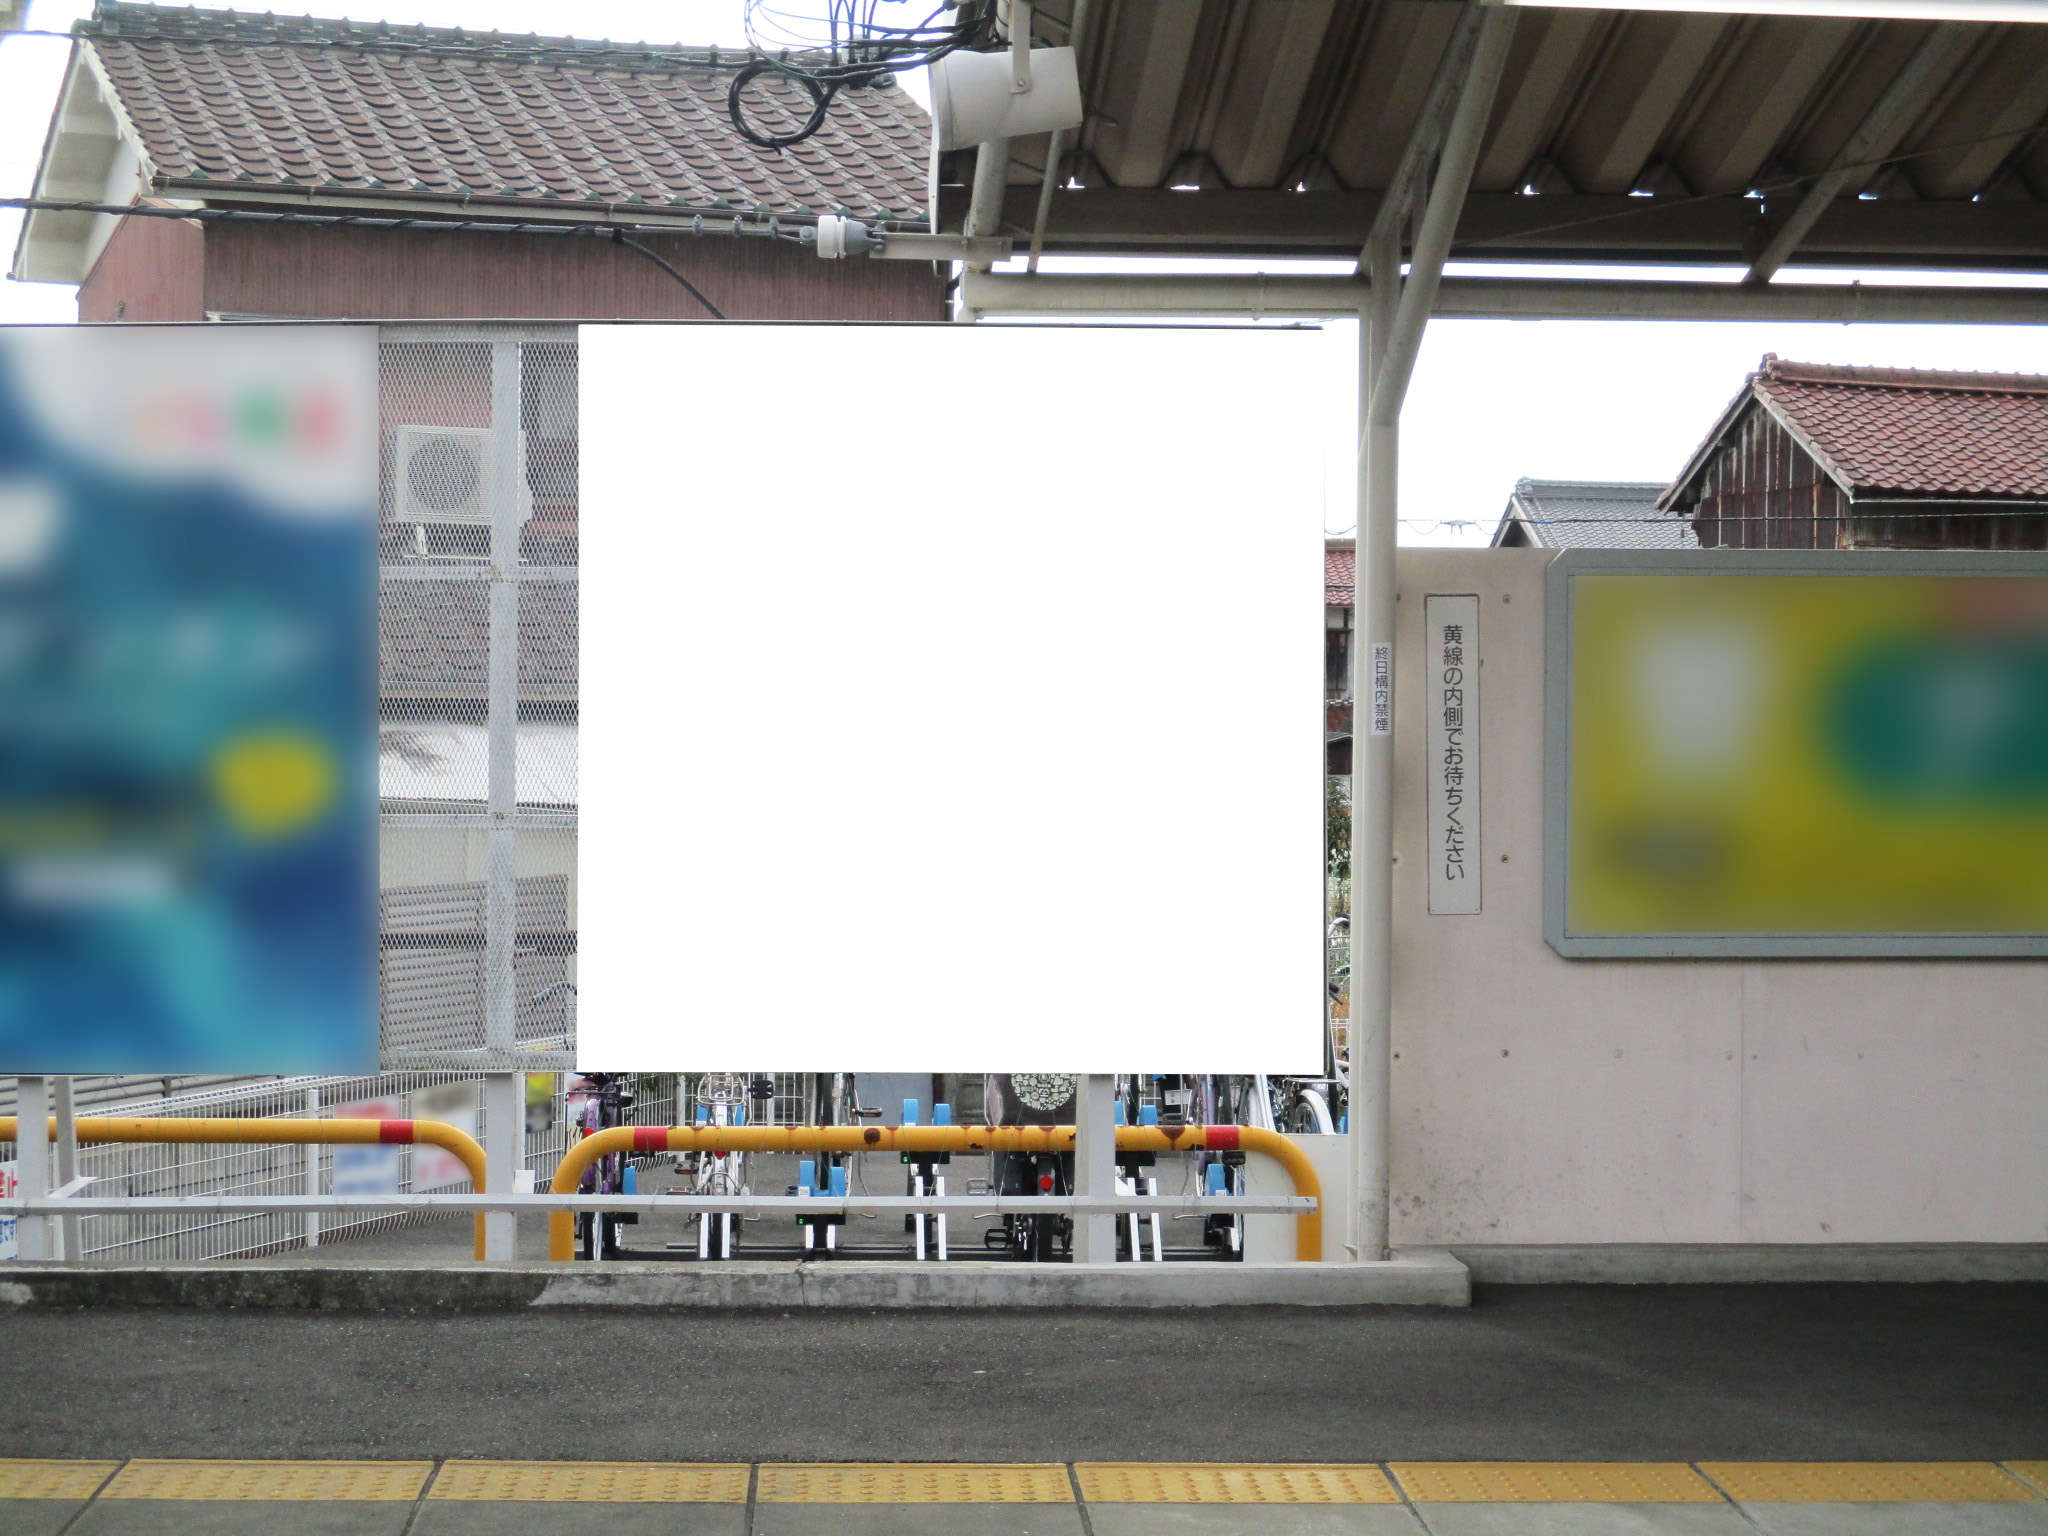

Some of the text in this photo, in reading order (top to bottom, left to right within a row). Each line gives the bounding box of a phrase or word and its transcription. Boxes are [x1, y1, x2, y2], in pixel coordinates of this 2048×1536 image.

[1374, 646, 1389, 731] 終日構内禁煙
[1443, 624, 1464, 881] 黄線の内側でお待ちください
